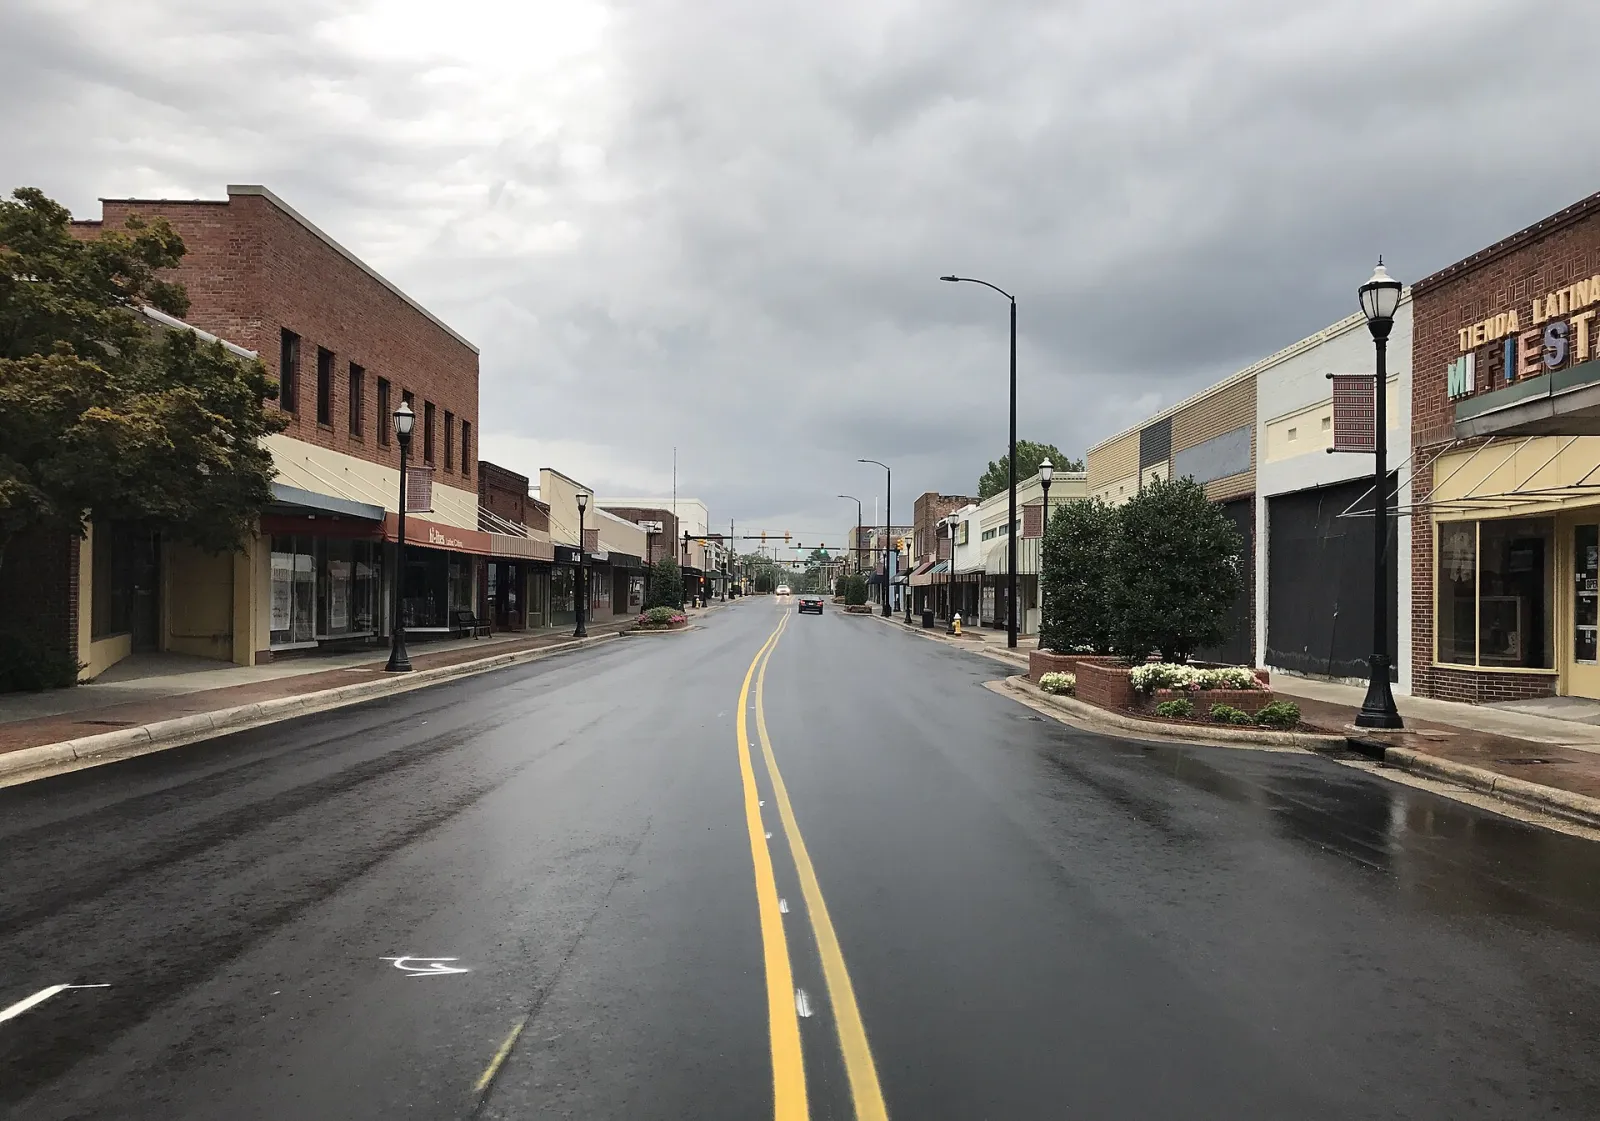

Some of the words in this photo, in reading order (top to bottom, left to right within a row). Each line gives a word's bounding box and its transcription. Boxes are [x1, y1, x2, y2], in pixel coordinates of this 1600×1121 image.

[1447, 352, 1476, 399] MI
[1482, 311, 1600, 388] FIEST
[1458, 309, 1520, 352] TIENDA
